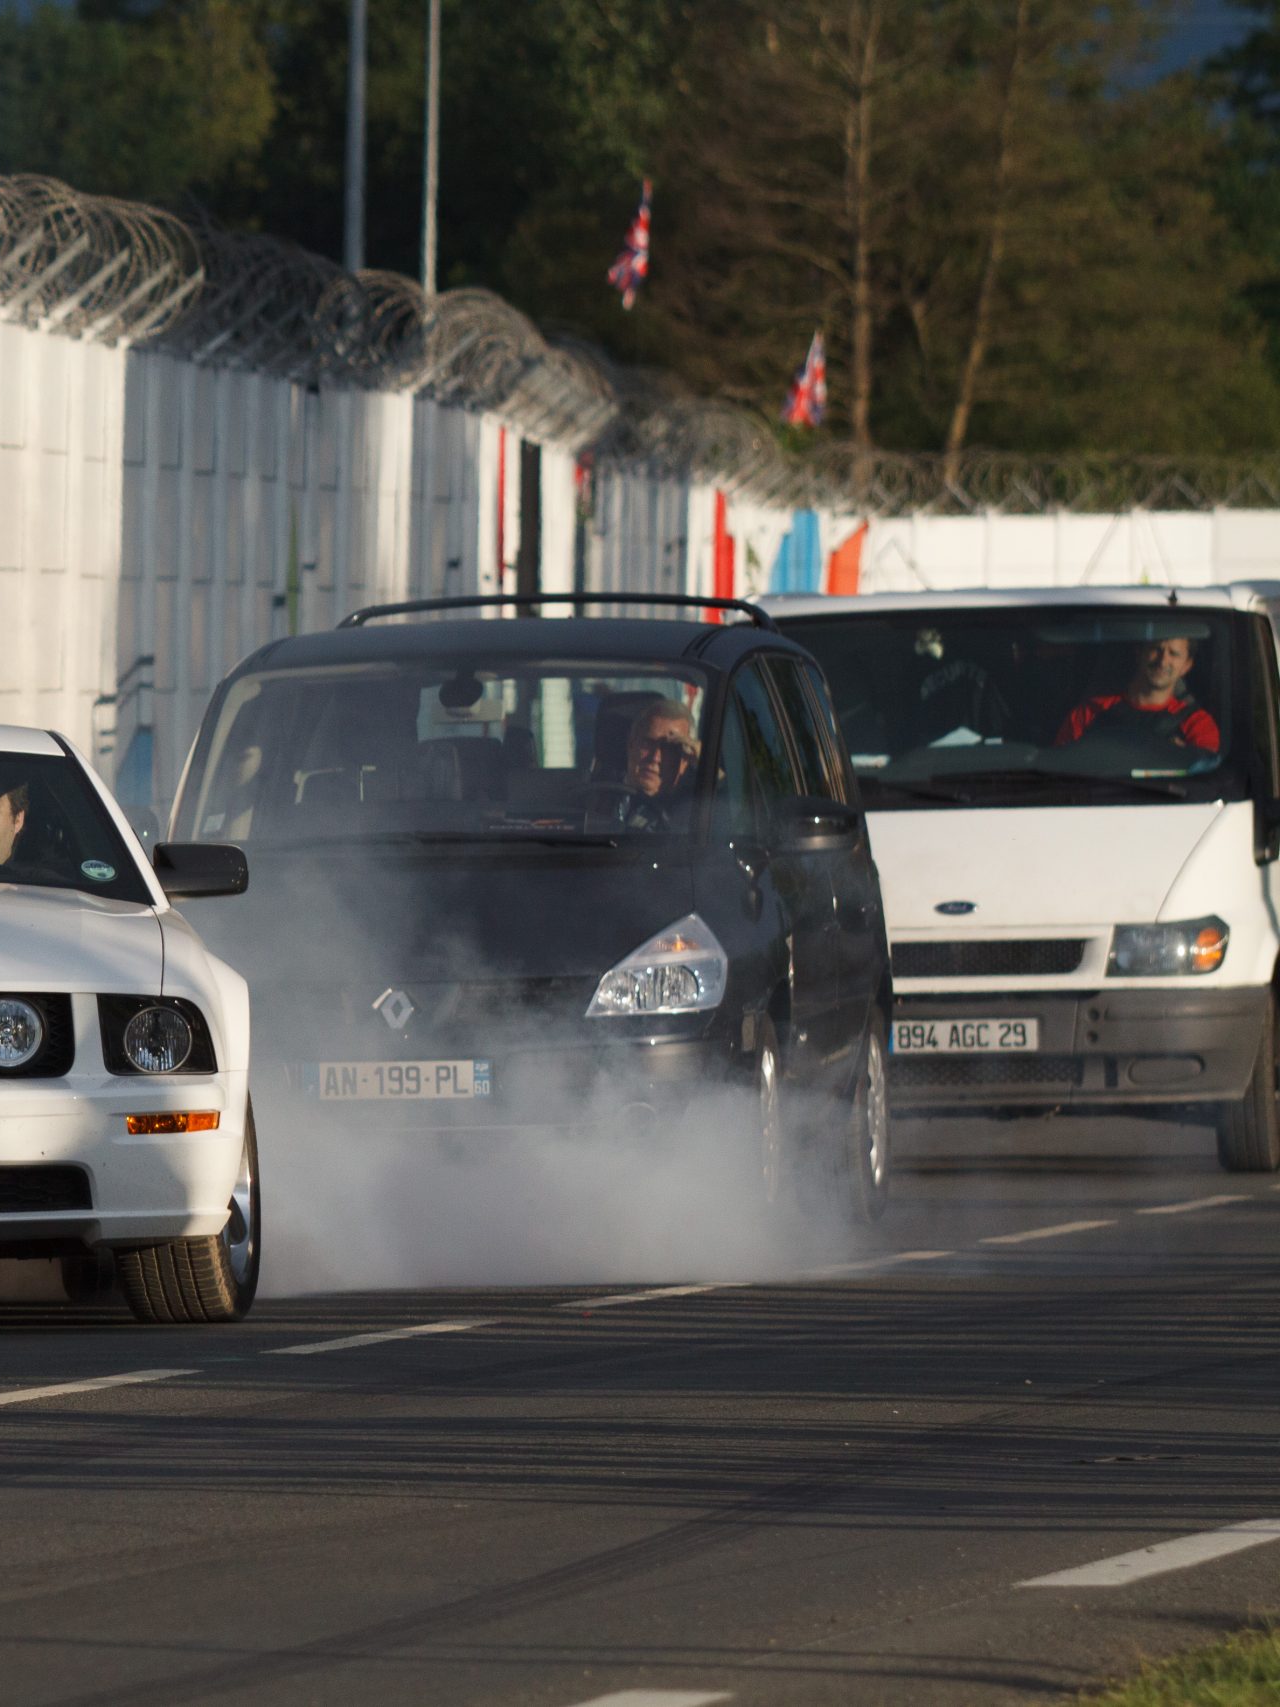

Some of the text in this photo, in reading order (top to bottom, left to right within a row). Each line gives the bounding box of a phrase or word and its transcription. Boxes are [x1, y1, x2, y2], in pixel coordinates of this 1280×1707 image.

[898, 1023, 1028, 1049] 894 AGC 29
[473, 1079, 490, 1096] 60
